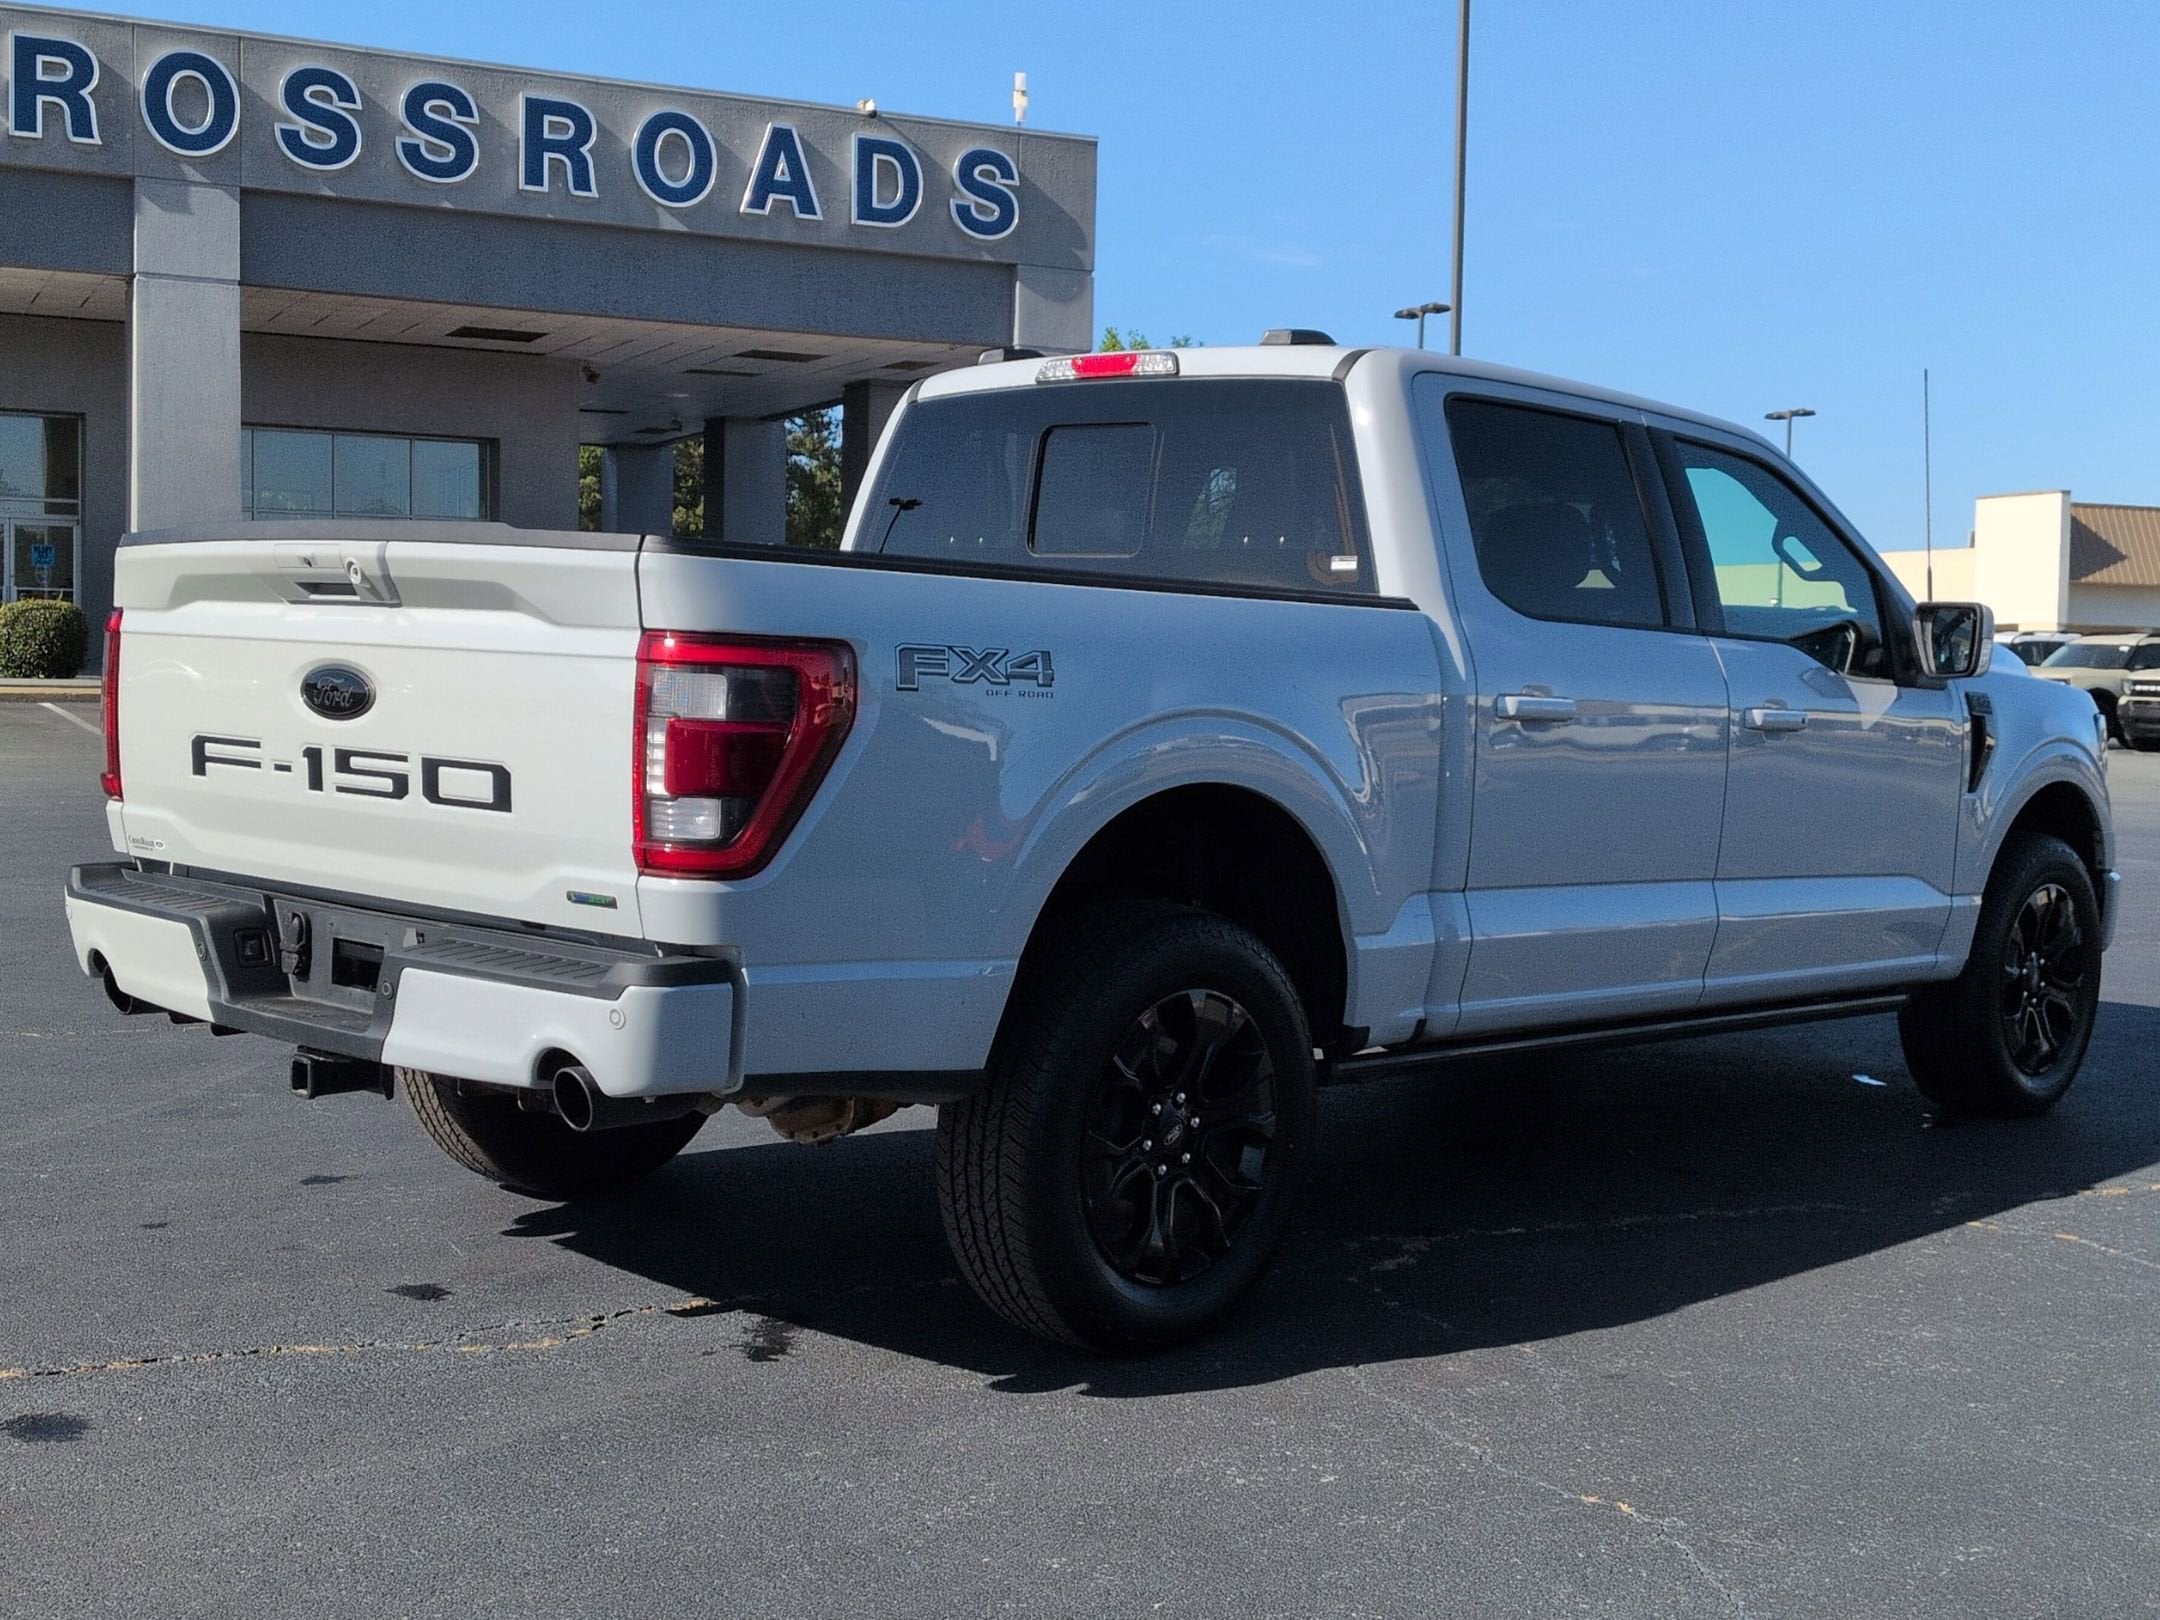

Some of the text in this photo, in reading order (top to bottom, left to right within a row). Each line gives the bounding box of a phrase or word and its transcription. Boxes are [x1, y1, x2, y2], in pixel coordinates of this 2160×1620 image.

[8, 30, 1020, 242] ROSSROADS
[313, 675, 354, 708] Ford
[894, 642, 1055, 692] FX4
[985, 688, 1055, 699] OFF ROAD
[190, 733, 513, 814] F-150
